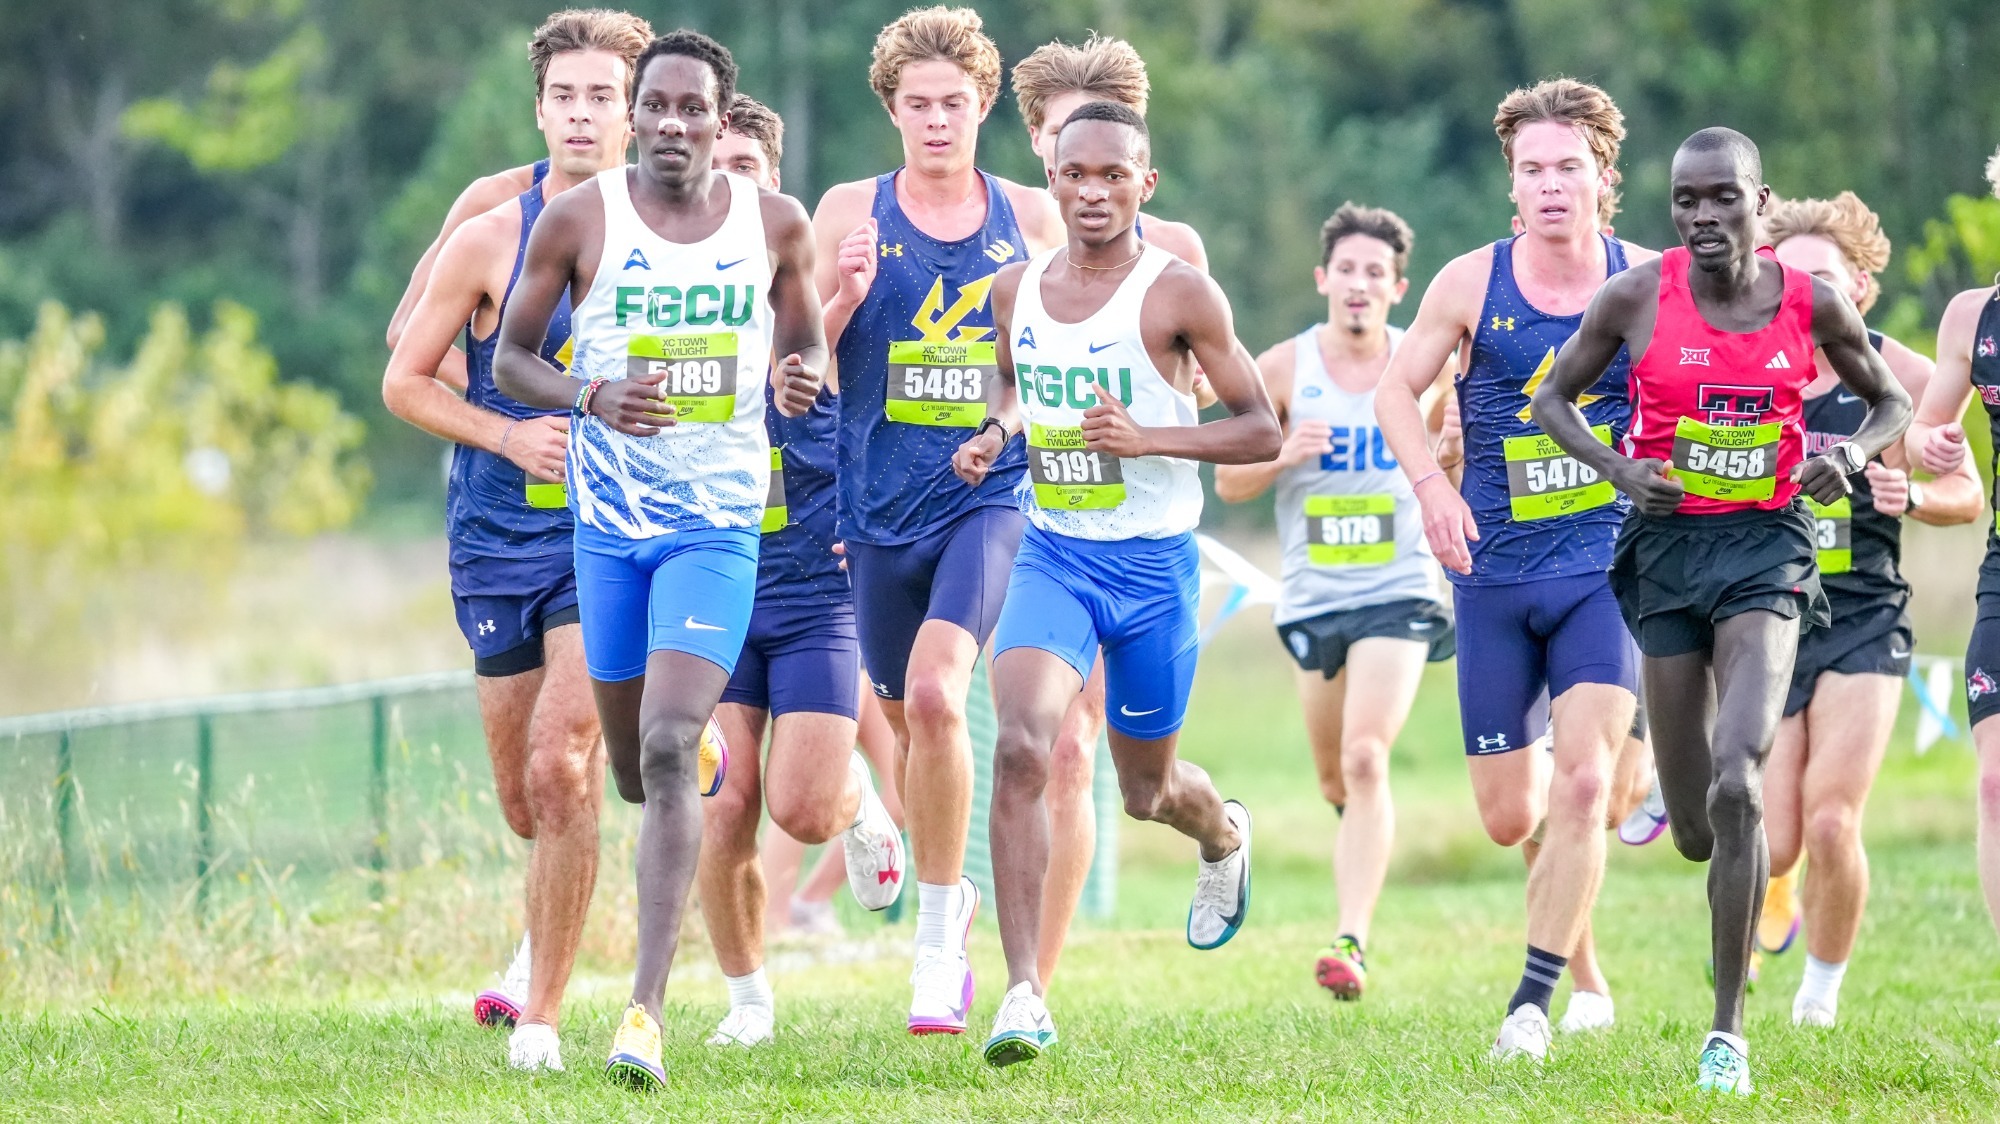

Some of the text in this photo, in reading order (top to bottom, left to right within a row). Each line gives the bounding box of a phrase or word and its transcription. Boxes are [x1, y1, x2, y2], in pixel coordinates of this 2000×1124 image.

[615, 285, 754, 327] FGCU
[662, 347, 708, 356] TWILIGHT
[663, 337, 707, 347] XC TOWN
[923, 346, 966, 354] XC TOWN
[922, 355, 967, 363] TWILIGHT
[648, 360, 721, 393] 5189
[904, 367, 982, 400] 5483
[1016, 363, 1132, 410] FGCU
[1977, 385, 2000, 405] RE
[1046, 429, 1056, 438] XC
[1536, 438, 1549, 447] XC
[1709, 436, 1755, 446] TWILIGHT
[1726, 430, 1755, 438] TOWN
[1320, 426, 1398, 471] EIU
[1687, 443, 1765, 479] 5458
[1040, 451, 1102, 482] 5191
[1526, 457, 1598, 493] 5478
[1321, 515, 1381, 545] 5179
